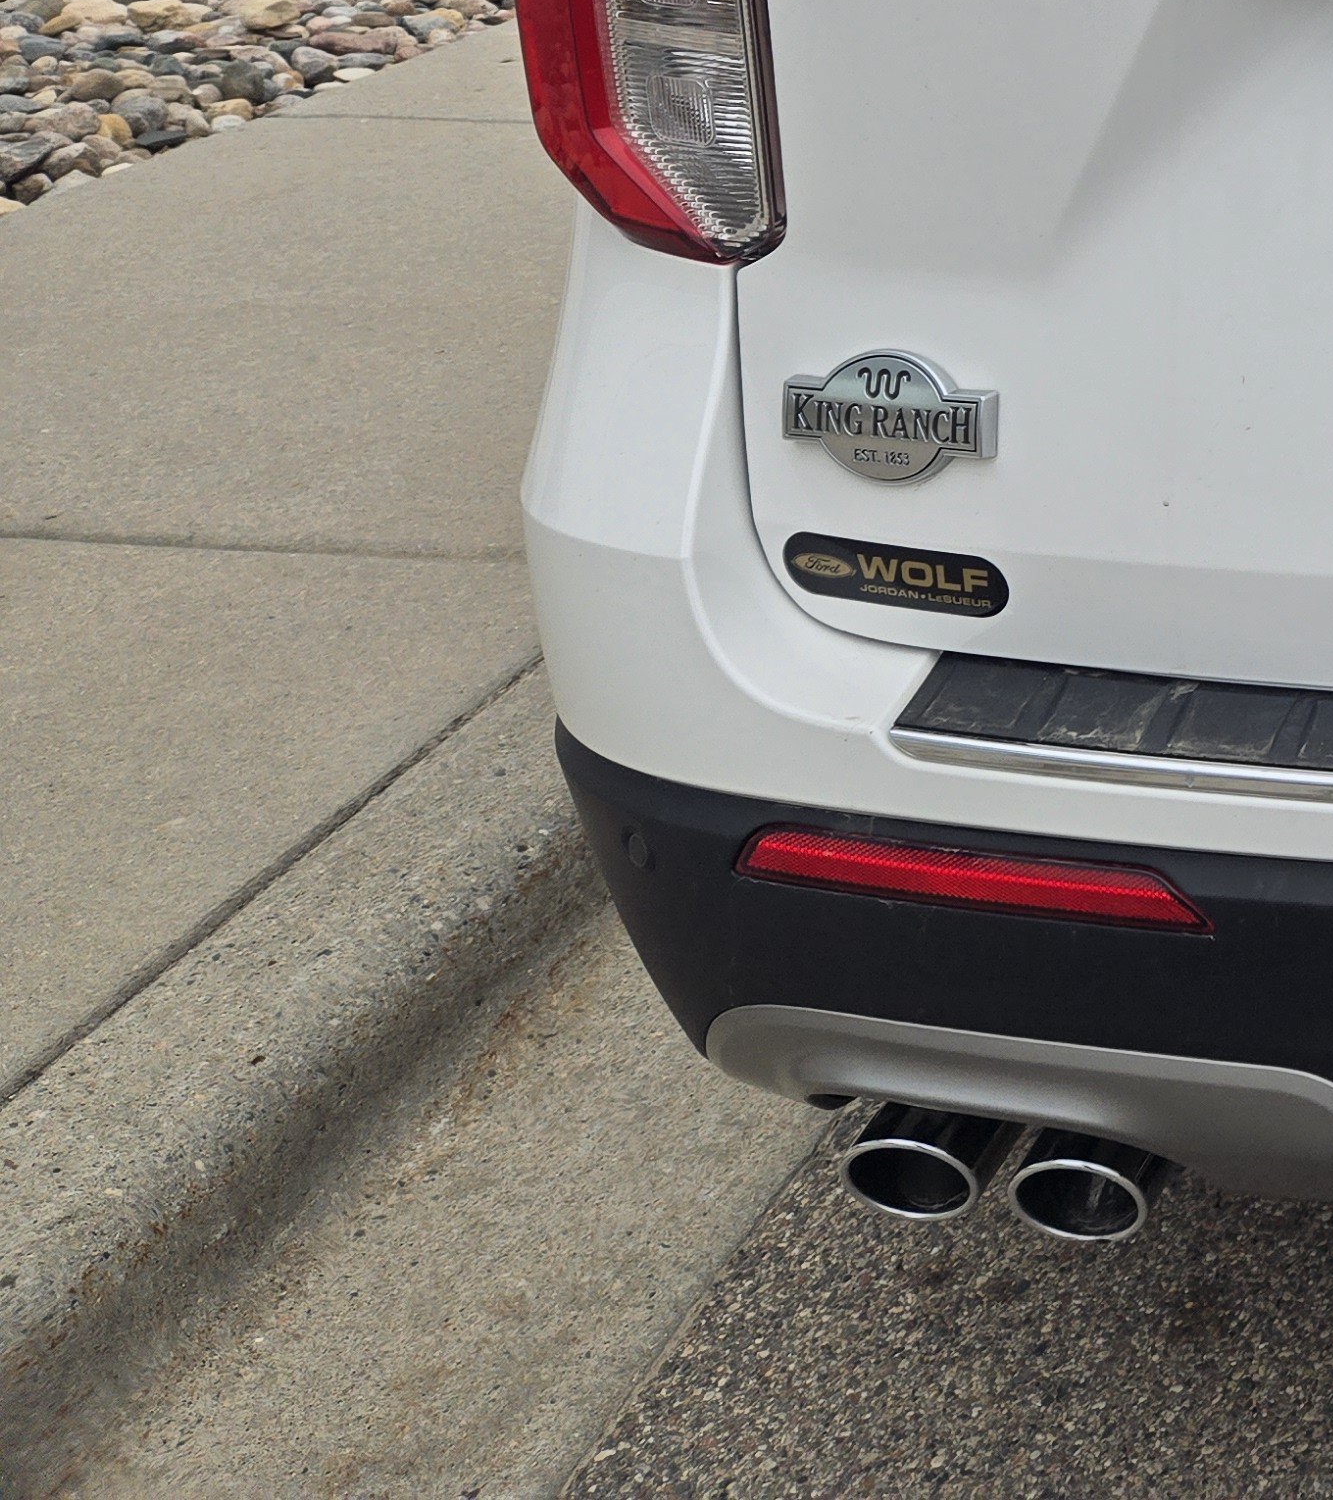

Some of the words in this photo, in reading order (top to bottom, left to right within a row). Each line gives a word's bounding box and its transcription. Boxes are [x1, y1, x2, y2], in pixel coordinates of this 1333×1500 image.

[791, 392, 863, 437] KING
[870, 404, 973, 445] RANCH
[853, 448, 881, 464] EST.
[883, 450, 910, 466] 1853
[804, 555, 841, 574] Ford
[856, 553, 989, 593] WOLF
[859, 584, 919, 599] JORDAN
